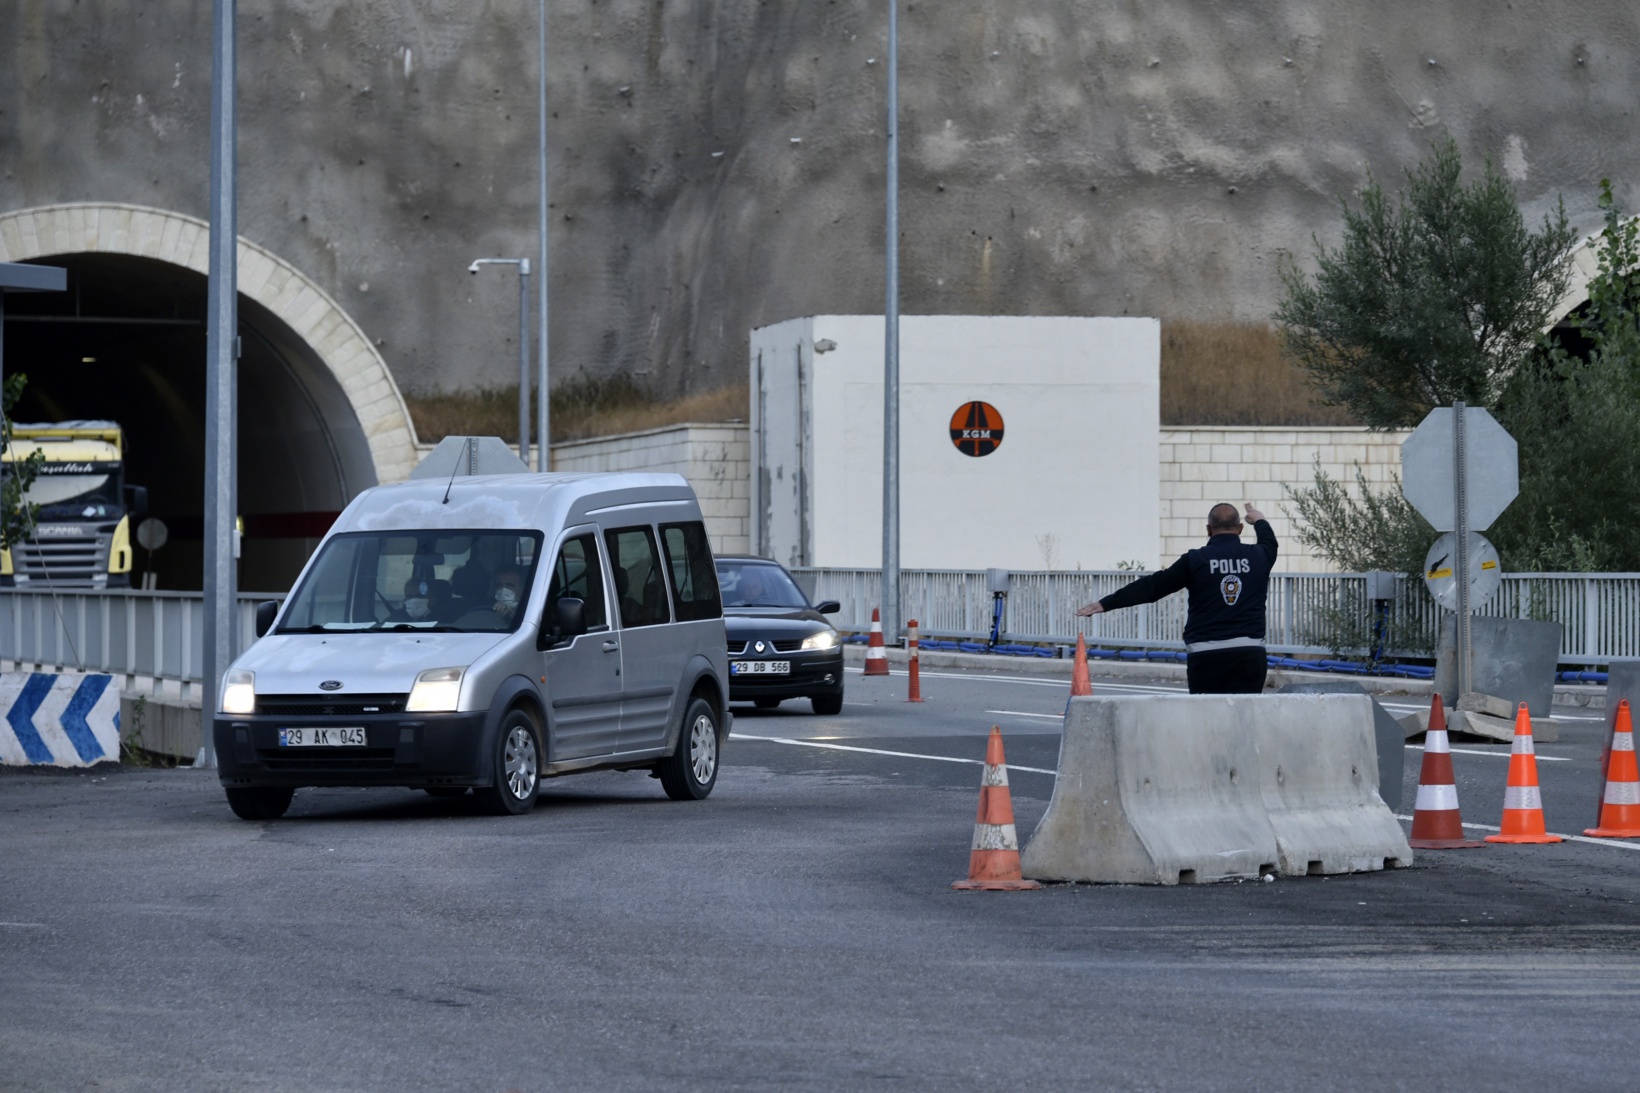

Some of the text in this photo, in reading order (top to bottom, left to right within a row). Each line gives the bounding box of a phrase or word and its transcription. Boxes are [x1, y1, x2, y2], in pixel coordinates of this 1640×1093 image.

[962, 429, 991, 439] KGM
[1209, 558, 1251, 574] POLIS
[736, 662, 789, 672] 29 DB 566
[288, 729, 364, 744] 29 AK 045
